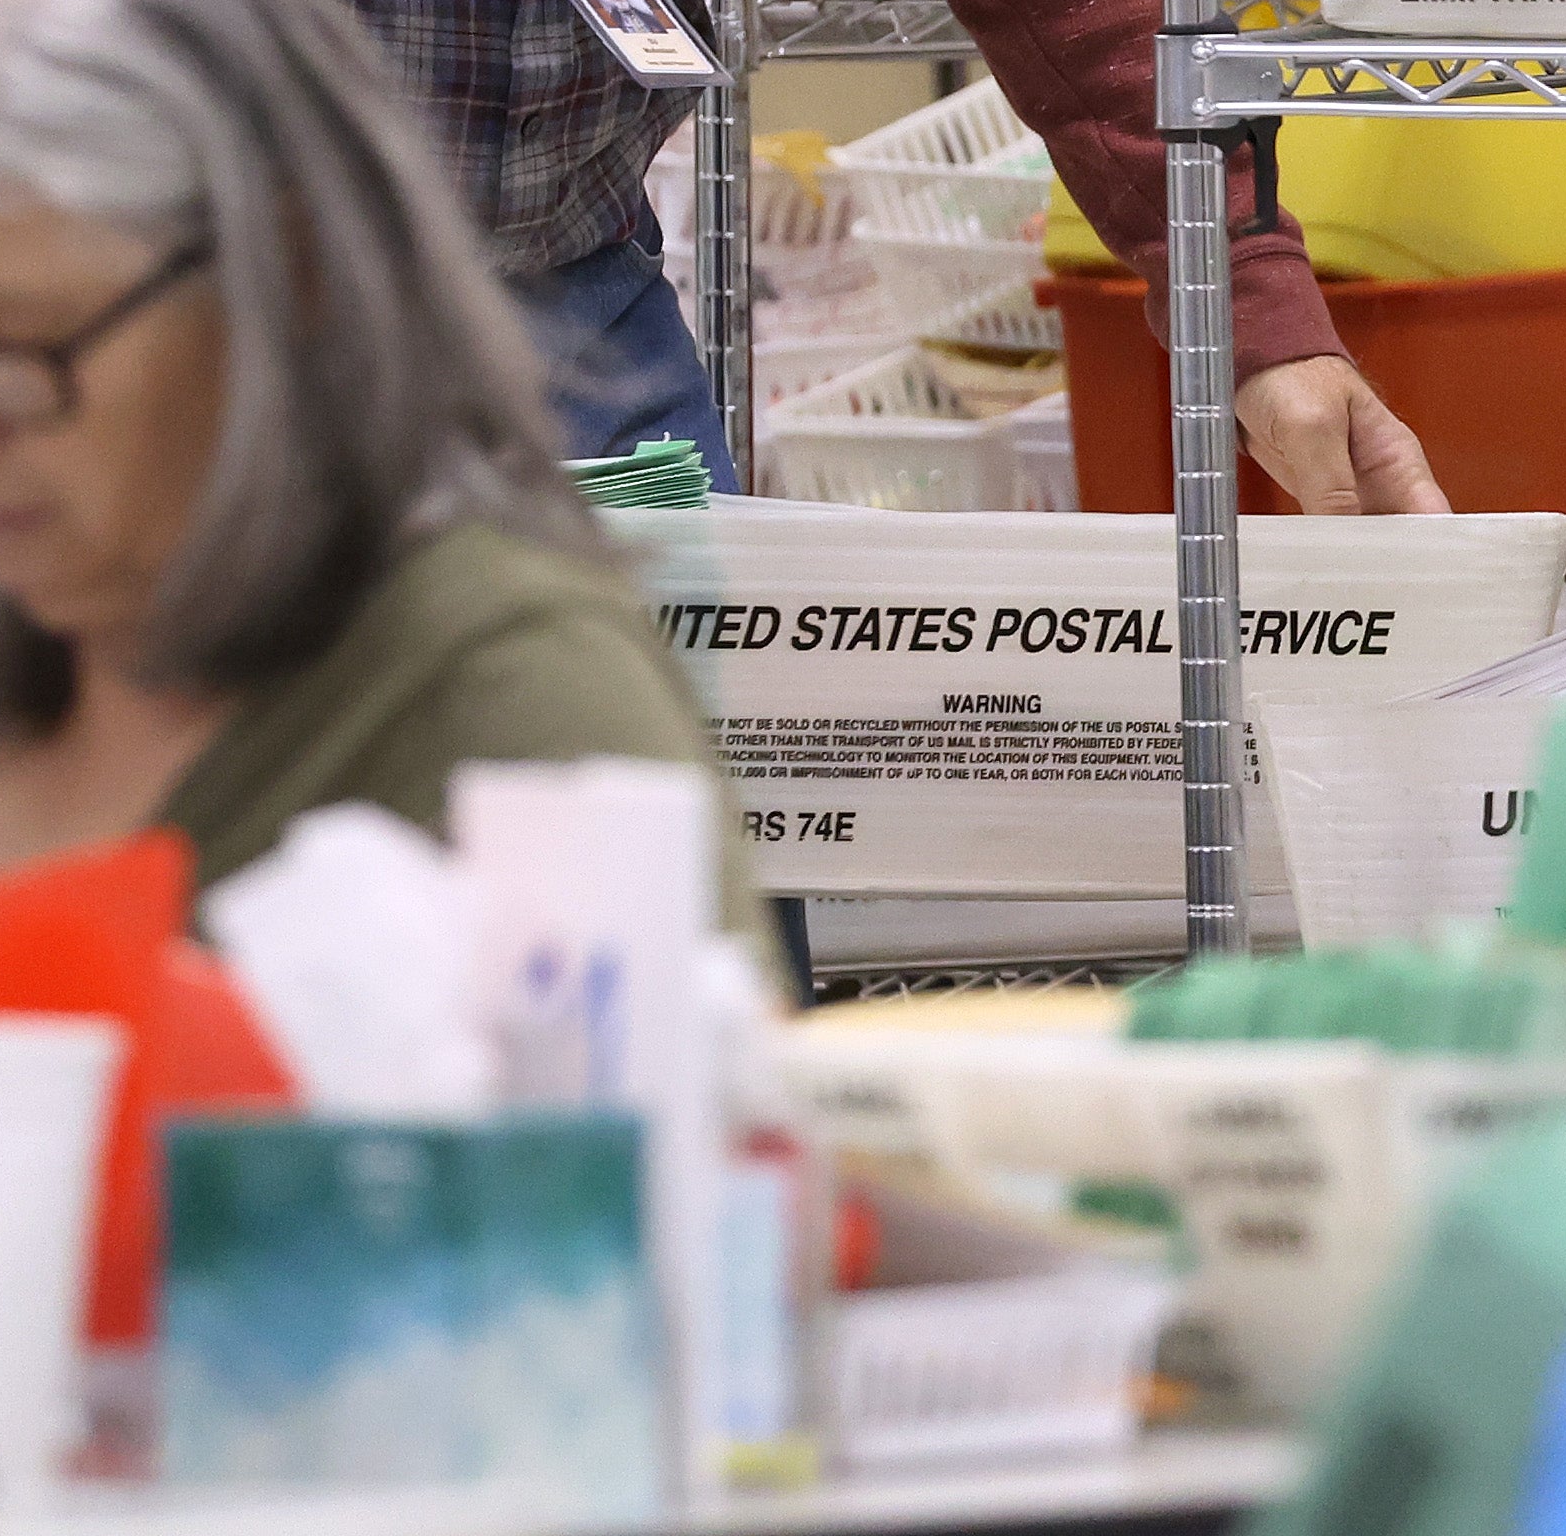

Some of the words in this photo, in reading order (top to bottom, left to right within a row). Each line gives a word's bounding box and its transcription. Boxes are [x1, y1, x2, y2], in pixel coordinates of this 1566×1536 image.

[659, 604, 781, 650] ITED
[791, 605, 973, 653] STATES
[988, 606, 1173, 654] POSTAL
[1240, 609, 1396, 657] ERVICE
[943, 694, 1042, 714] WARNING
[728, 718, 753, 732] NOT
[756, 718, 773, 732] BE
[776, 718, 810, 732] SOLD
[812, 718, 831, 732] OR
[834, 718, 900, 732] RECYCLED
[901, 718, 956, 733] WITHOUT
[959, 719, 982, 733] THE
[985, 719, 1059, 733] PERMISSION
[1062, 719, 1078, 733] OF
[1081, 719, 1103, 733] THE
[1106, 719, 1123, 733] US
[1125, 719, 1169, 734] POSTAL
[726, 734, 768, 748] OTHER
[770, 734, 803, 748] THAN
[806, 734, 829, 748] THE
[832, 734, 904, 749] TRANSPORT
[908, 735, 924, 749] OF
[928, 735, 944, 749] US
[947, 735, 975, 749] MAIL
[979, 735, 991, 749] IS
[742, 810, 786, 842] RS
[798, 811, 856, 842] 74E
